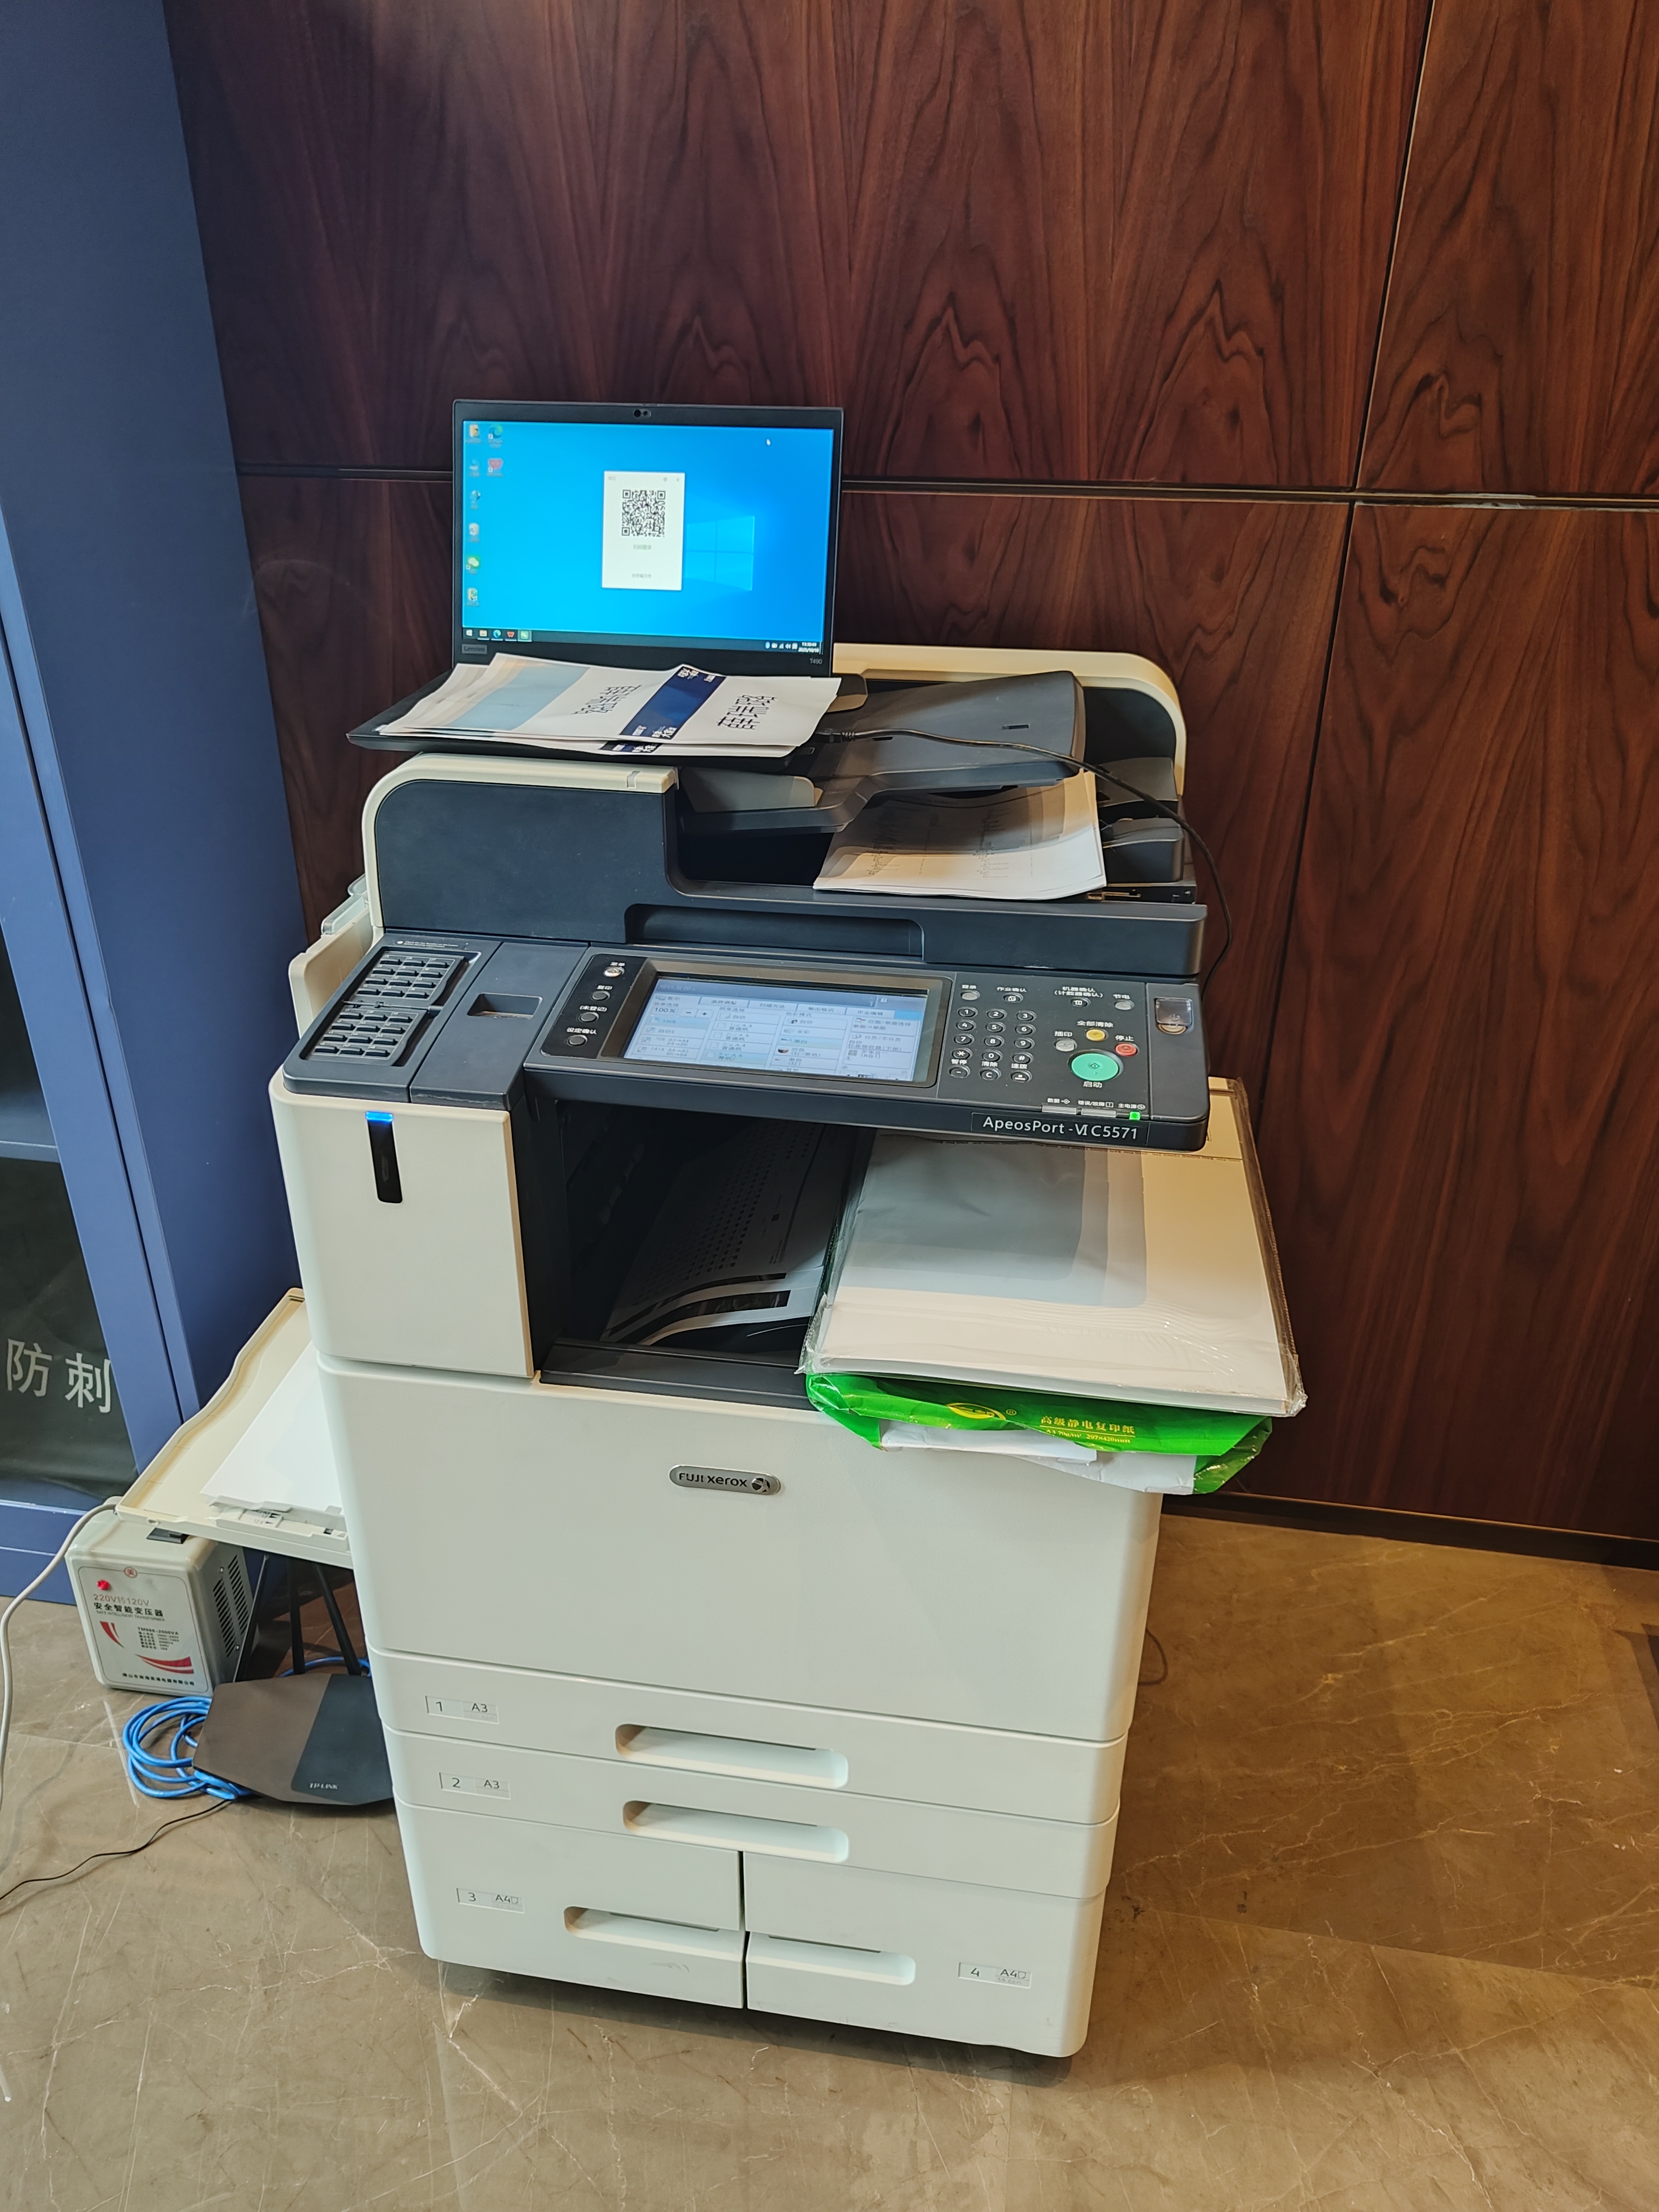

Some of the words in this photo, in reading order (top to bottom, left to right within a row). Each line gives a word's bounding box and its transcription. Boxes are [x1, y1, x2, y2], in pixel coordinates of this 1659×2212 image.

[983, 1116, 1064, 1134] ApeosPort
[1091, 1125, 1137, 1140] C5571
[7, 1338, 111, 1413] 防刺
[1041, 1415, 1135, 1434] 高级静电复印纸
[679, 1473, 704, 1482] FUJI
[707, 1475, 747, 1487] xerox
[93, 1594, 149, 1606] 220V转120V
[93, 1602, 164, 1617] 安全智能变压器
[436, 1701, 442, 1711] 1
[471, 1703, 488, 1712] A3
[452, 1777, 461, 1788] 2
[484, 1779, 500, 1789] A3
[468, 1892, 476, 1901] 3
[495, 1894, 510, 1903] A4
[969, 1967, 979, 1977] 4
[1000, 1969, 1017, 1978] A4
